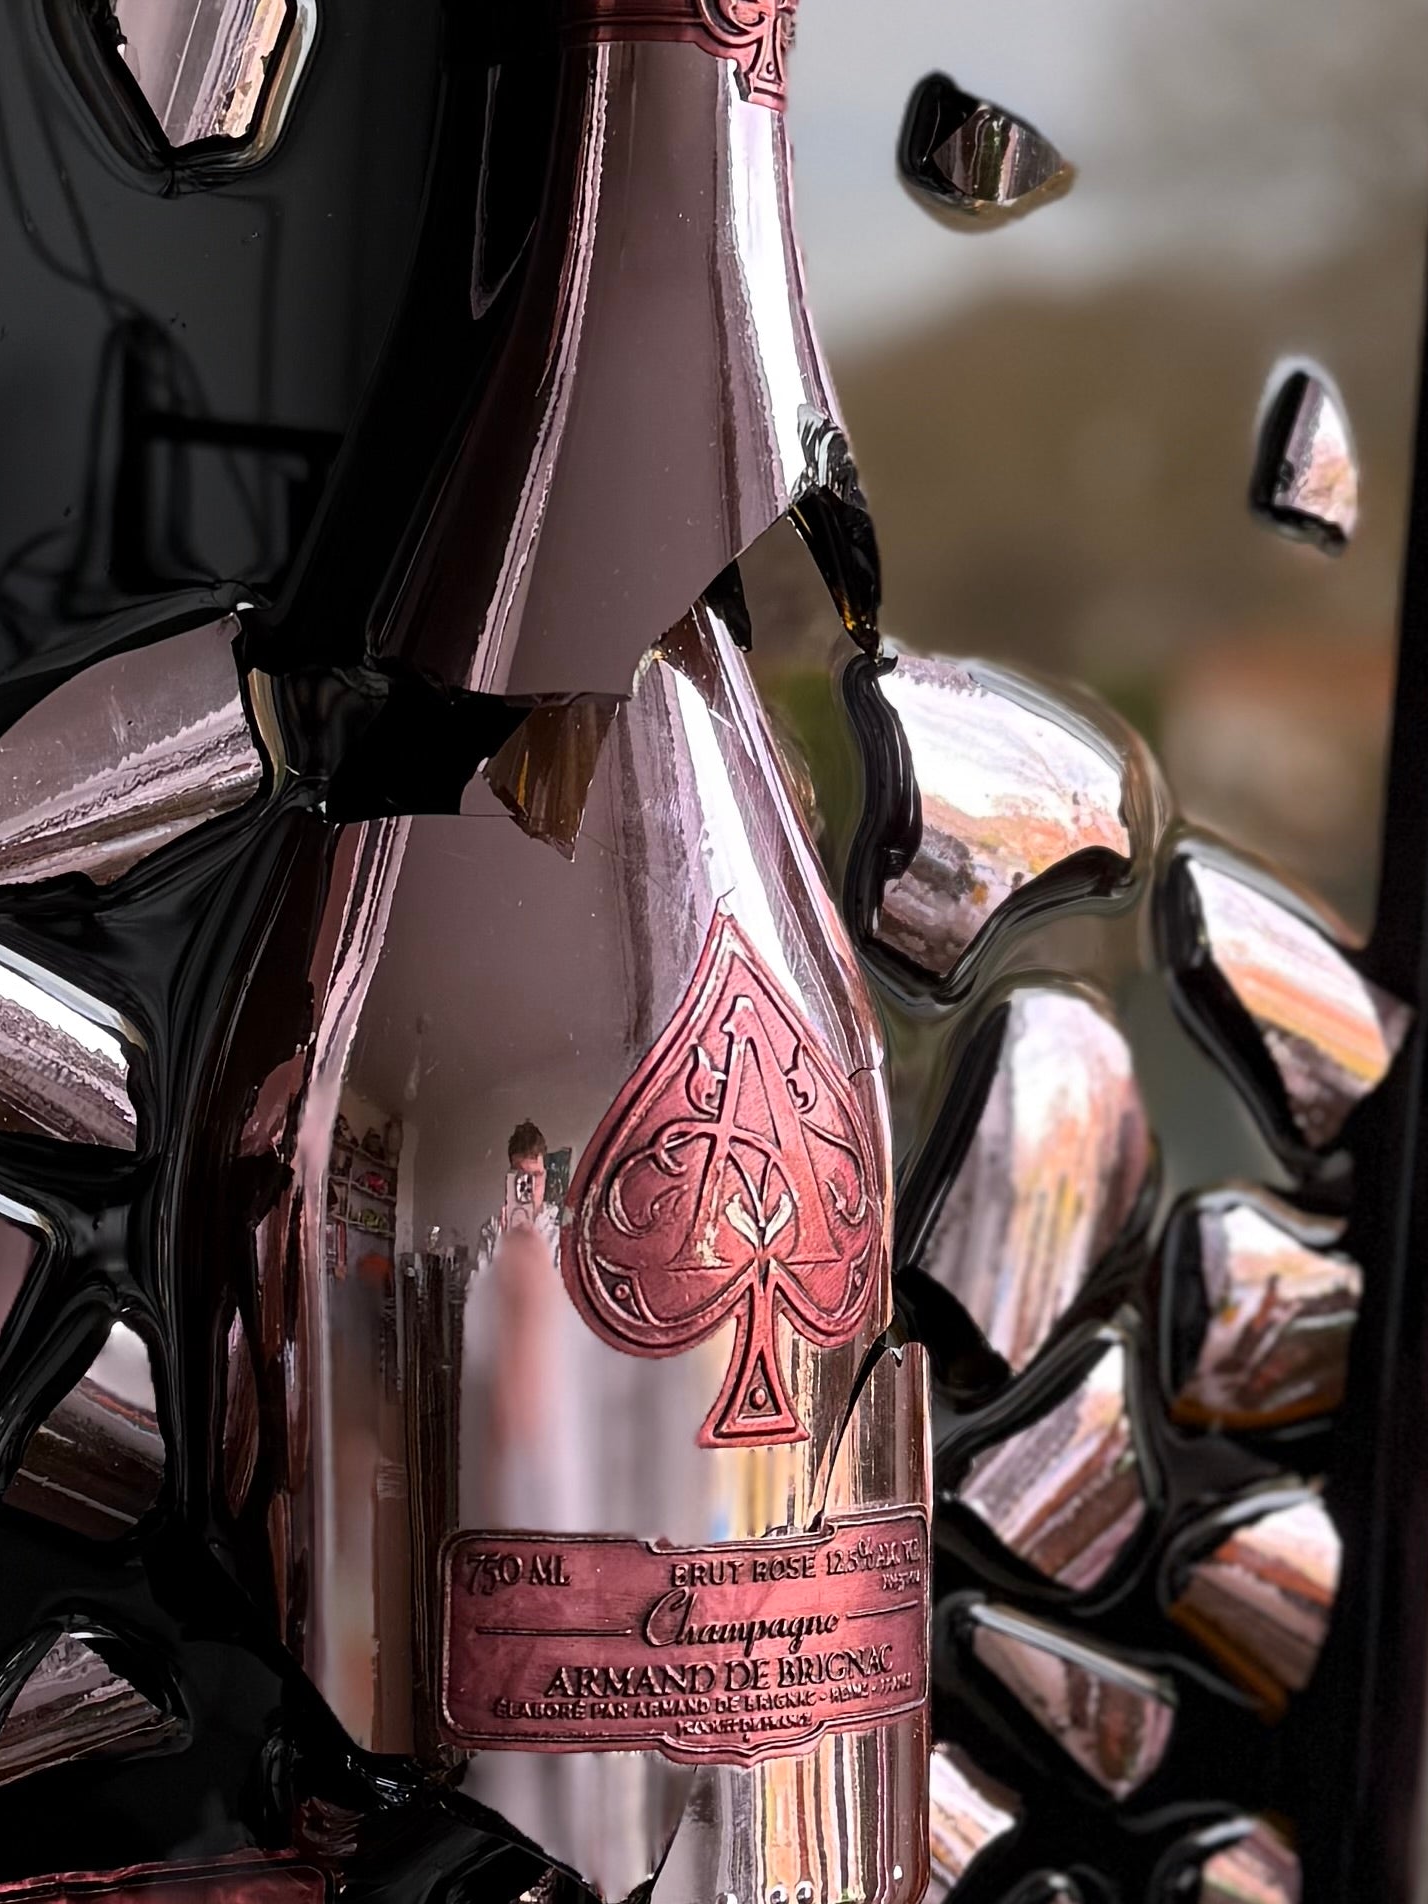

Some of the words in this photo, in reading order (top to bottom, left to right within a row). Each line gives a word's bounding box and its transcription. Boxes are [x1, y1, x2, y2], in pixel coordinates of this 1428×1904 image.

[465, 1552, 523, 1595] 750
[529, 1553, 572, 1586] ML
[671, 1560, 743, 1588] BRUT
[642, 1586, 839, 1657] Champagne
[544, 1661, 716, 1698] ARMAND
[723, 1659, 771, 1692] DE
[778, 1644, 894, 1687] BRIGNAC
[590, 1702, 628, 1720] PAR
[634, 1697, 712, 1719] ARMAND
[716, 1697, 740, 1714] DE
